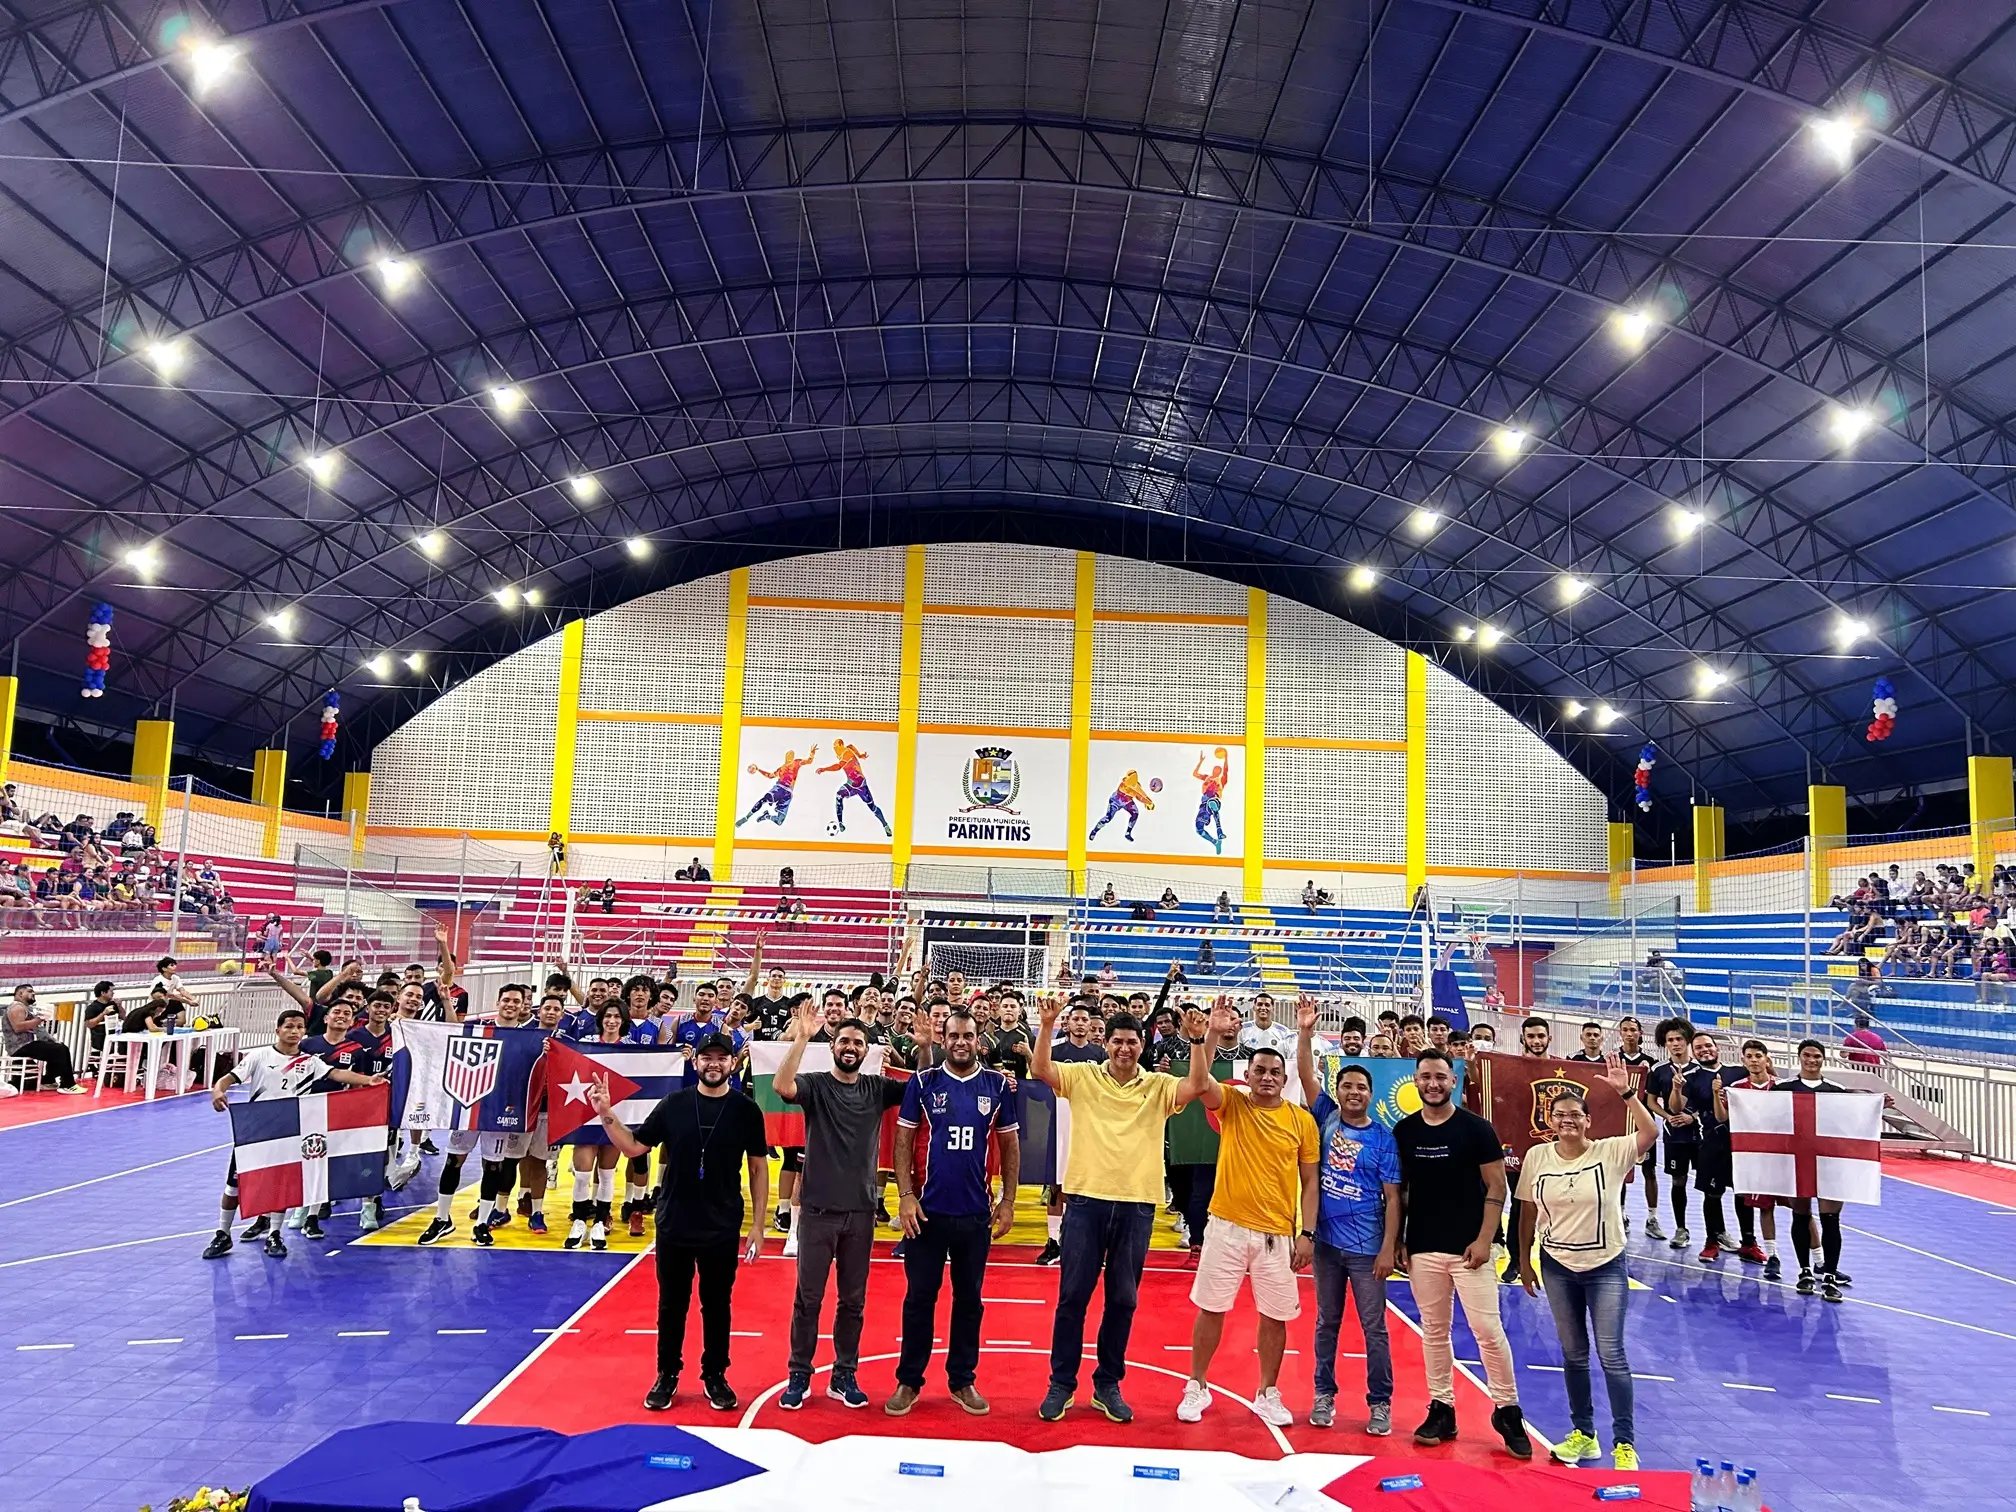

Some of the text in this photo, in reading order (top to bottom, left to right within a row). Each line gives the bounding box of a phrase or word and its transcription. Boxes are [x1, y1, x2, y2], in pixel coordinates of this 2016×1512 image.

[949, 816, 992, 824] PREFEITURA
[948, 823, 1031, 841] PARINTINS
[1433, 1006, 1459, 1014] VITALLY
[770, 1015, 778, 1025] 15
[452, 1040, 499, 1067] USA
[372, 1061, 382, 1073] 10
[281, 1078, 288, 1090] 2
[978, 1097, 990, 1105] USA
[408, 1113, 431, 1122] SANTOS
[496, 1116, 519, 1125] SANTOS
[947, 1126, 974, 1150] 38
[494, 1139, 504, 1154] 11
[1670, 1160, 1677, 1169] 9
[1331, 1172, 1355, 1184] MUNDIAL
